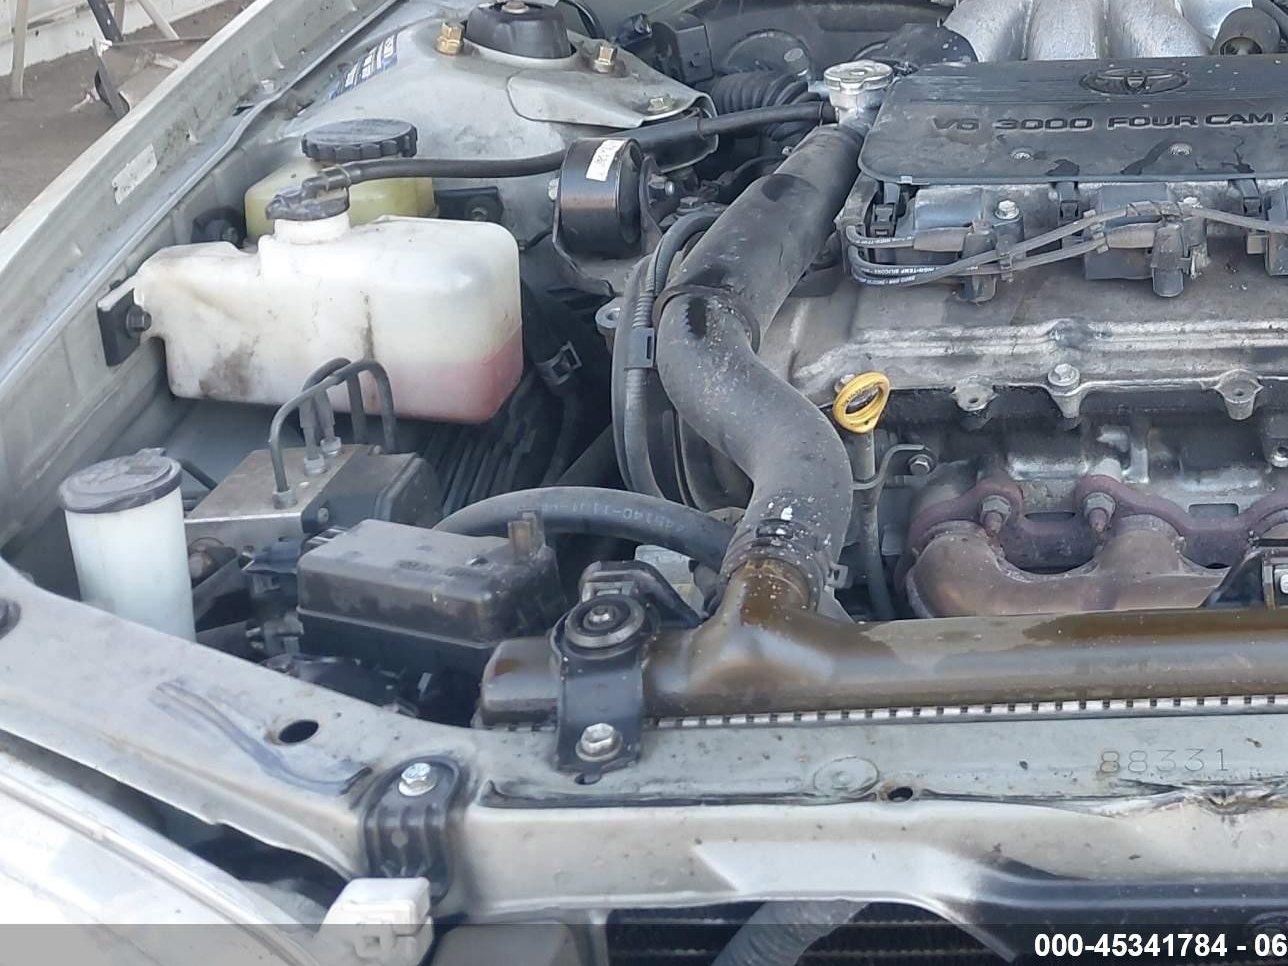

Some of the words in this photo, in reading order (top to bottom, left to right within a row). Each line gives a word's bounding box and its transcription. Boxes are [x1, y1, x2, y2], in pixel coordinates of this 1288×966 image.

[992, 117, 1095, 131] 3000
[1107, 113, 1199, 129] FOUR
[1205, 112, 1275, 127] CAM
[1099, 747, 1229, 773] 88331
